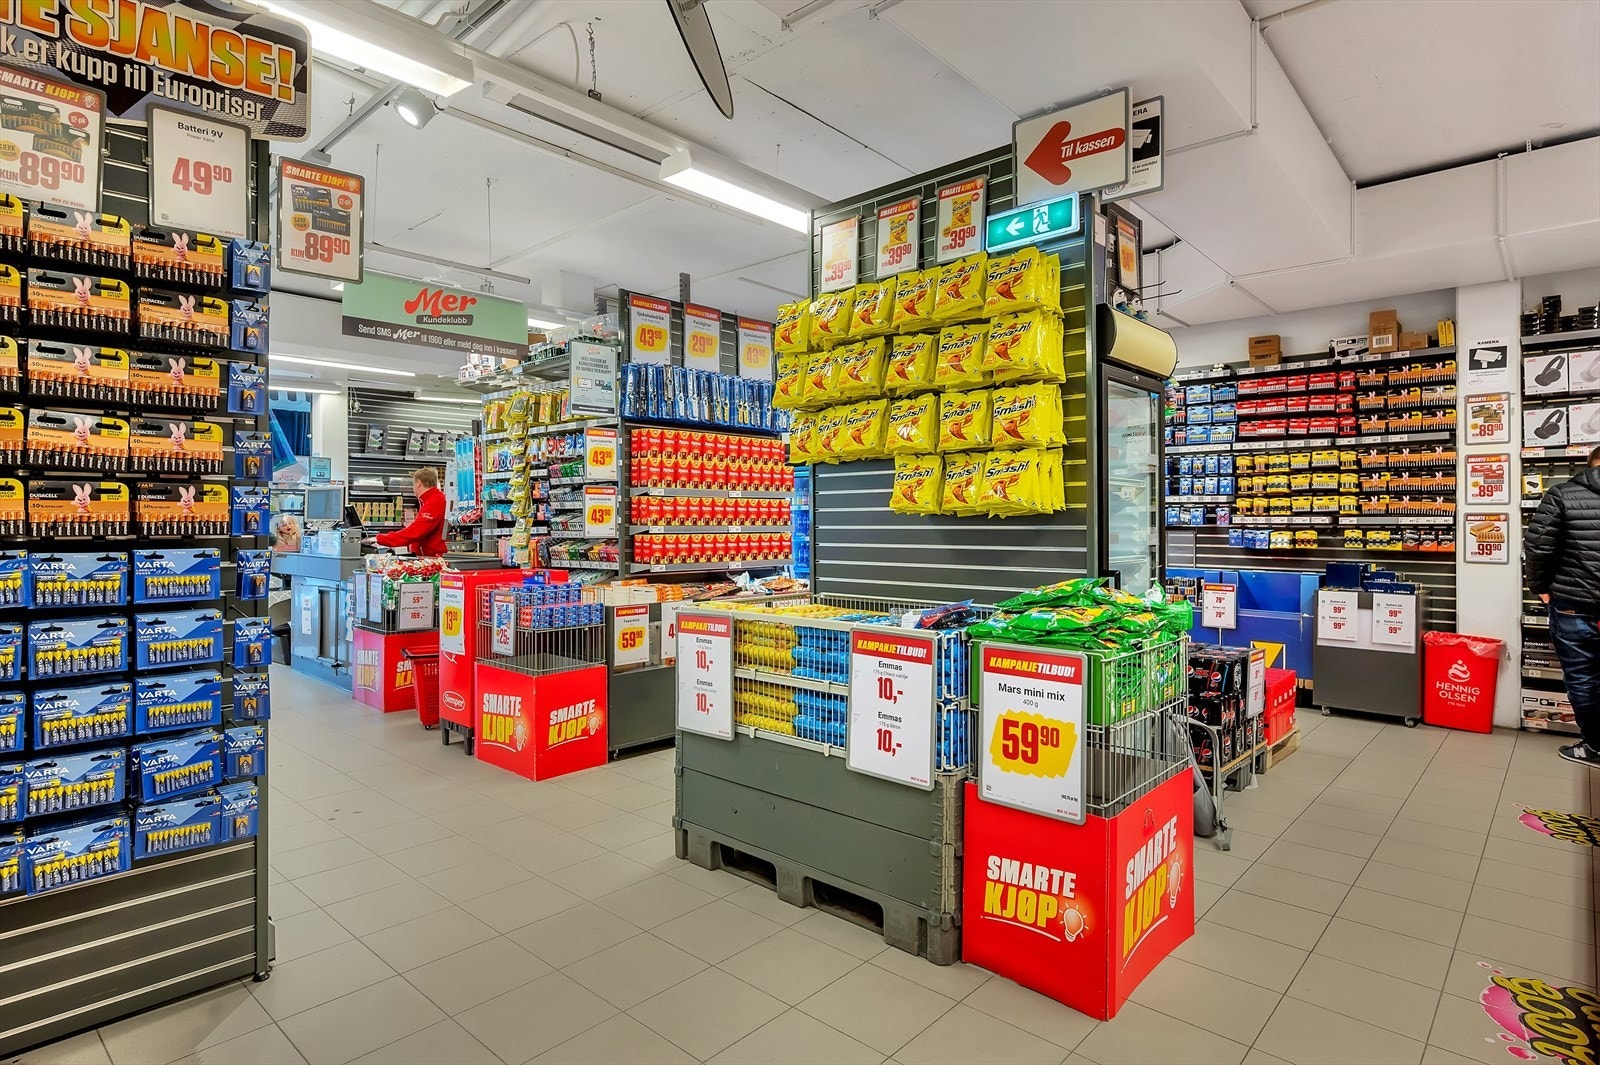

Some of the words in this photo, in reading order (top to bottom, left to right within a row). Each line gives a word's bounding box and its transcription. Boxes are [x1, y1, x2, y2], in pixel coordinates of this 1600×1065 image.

[65, 0, 296, 105] SJANSE!
[23, 38, 49, 66] et
[56, 41, 118, 86] kupp
[123, 63, 147, 92] til
[153, 69, 265, 122] Europriser
[177, 121, 210, 137] Batteri
[211, 130, 224, 140] 9V
[1060, 145, 1073, 159] Til
[1076, 134, 1115, 155] kassen
[286, 165, 321, 182] SMARTE
[321, 174, 346, 187] KJØP!
[941, 185, 962, 197] SMARTE
[880, 206, 898, 217] SMARTE
[234, 247, 270, 261] VARTA
[290, 247, 305, 259] KUN
[938, 261, 980, 286] Smash!
[987, 257, 1033, 282] Smash!
[404, 287, 477, 318] Mer
[234, 310, 268, 322] VARTA
[422, 315, 468, 324] Kundeklubb
[358, 324, 376, 335] Send
[376, 327, 392, 337] SMS
[393, 328, 421, 341] Mer
[428, 335, 443, 345] 1960
[443, 337, 457, 347] eller
[457, 339, 472, 349] meld
[472, 341, 484, 352] deg
[988, 320, 1033, 341] Smash!
[940, 332, 981, 353] Smash!
[231, 373, 265, 383] VARTA
[889, 403, 928, 423] Smash!
[941, 400, 982, 421] Smash!
[993, 395, 1037, 418] Smash!
[236, 441, 272, 449] VARTA
[896, 467, 935, 482] Smash!
[945, 461, 981, 481] Smash!
[985, 459, 1031, 478] Smash!
[31, 562, 77, 570] VARTA
[245, 561, 270, 569] VARTA
[137, 626, 177, 635] VARTA
[236, 628, 271, 636] VARTA
[681, 620, 728, 633] KAMPANJETILBUD!
[30, 631, 75, 640] VARTA
[696, 636, 713, 646] Emmas
[857, 639, 927, 658] KAMPANJETILBUD!
[357, 649, 379, 666] SMARTE
[696, 650, 714, 673] 10,-
[878, 660, 903, 672] Emmas
[989, 656, 1076, 678] KAMPANJETILBUD!
[233, 683, 268, 691] VARTA
[696, 678, 714, 688] Emmas
[877, 676, 904, 705] 10,-
[1436, 681, 1481, 695] HENNIG
[138, 689, 177, 699] VARTA
[444, 692, 465, 707] Semper
[998, 682, 1022, 695] Mars
[1023, 687, 1045, 699] mini
[1047, 690, 1066, 702] mix
[1438, 690, 1478, 703] OLSEN
[35, 699, 80, 711] VARTA
[483, 692, 522, 717] SMARTE
[696, 692, 714, 715] 10,-
[1022, 698, 1034, 707] 400
[1034, 701, 1039, 709] g
[549, 699, 596, 726] SMARTE
[878, 711, 902, 723] Emmas
[482, 713, 515, 744] KJØP
[548, 715, 588, 746] KJØP
[228, 738, 264, 748] VARTA
[876, 728, 903, 757] 10,-
[142, 753, 180, 767] VARTA
[24, 767, 69, 778] VARTA
[223, 799, 258, 811] VARTA
[137, 813, 177, 826] VARTA
[26, 840, 72, 855] VARTA
[1125, 814, 1178, 900] SMARTE
[986, 855, 1077, 899] SMARTE
[983, 880, 1058, 928] KJØP
[1122, 862, 1168, 959] KJØP
